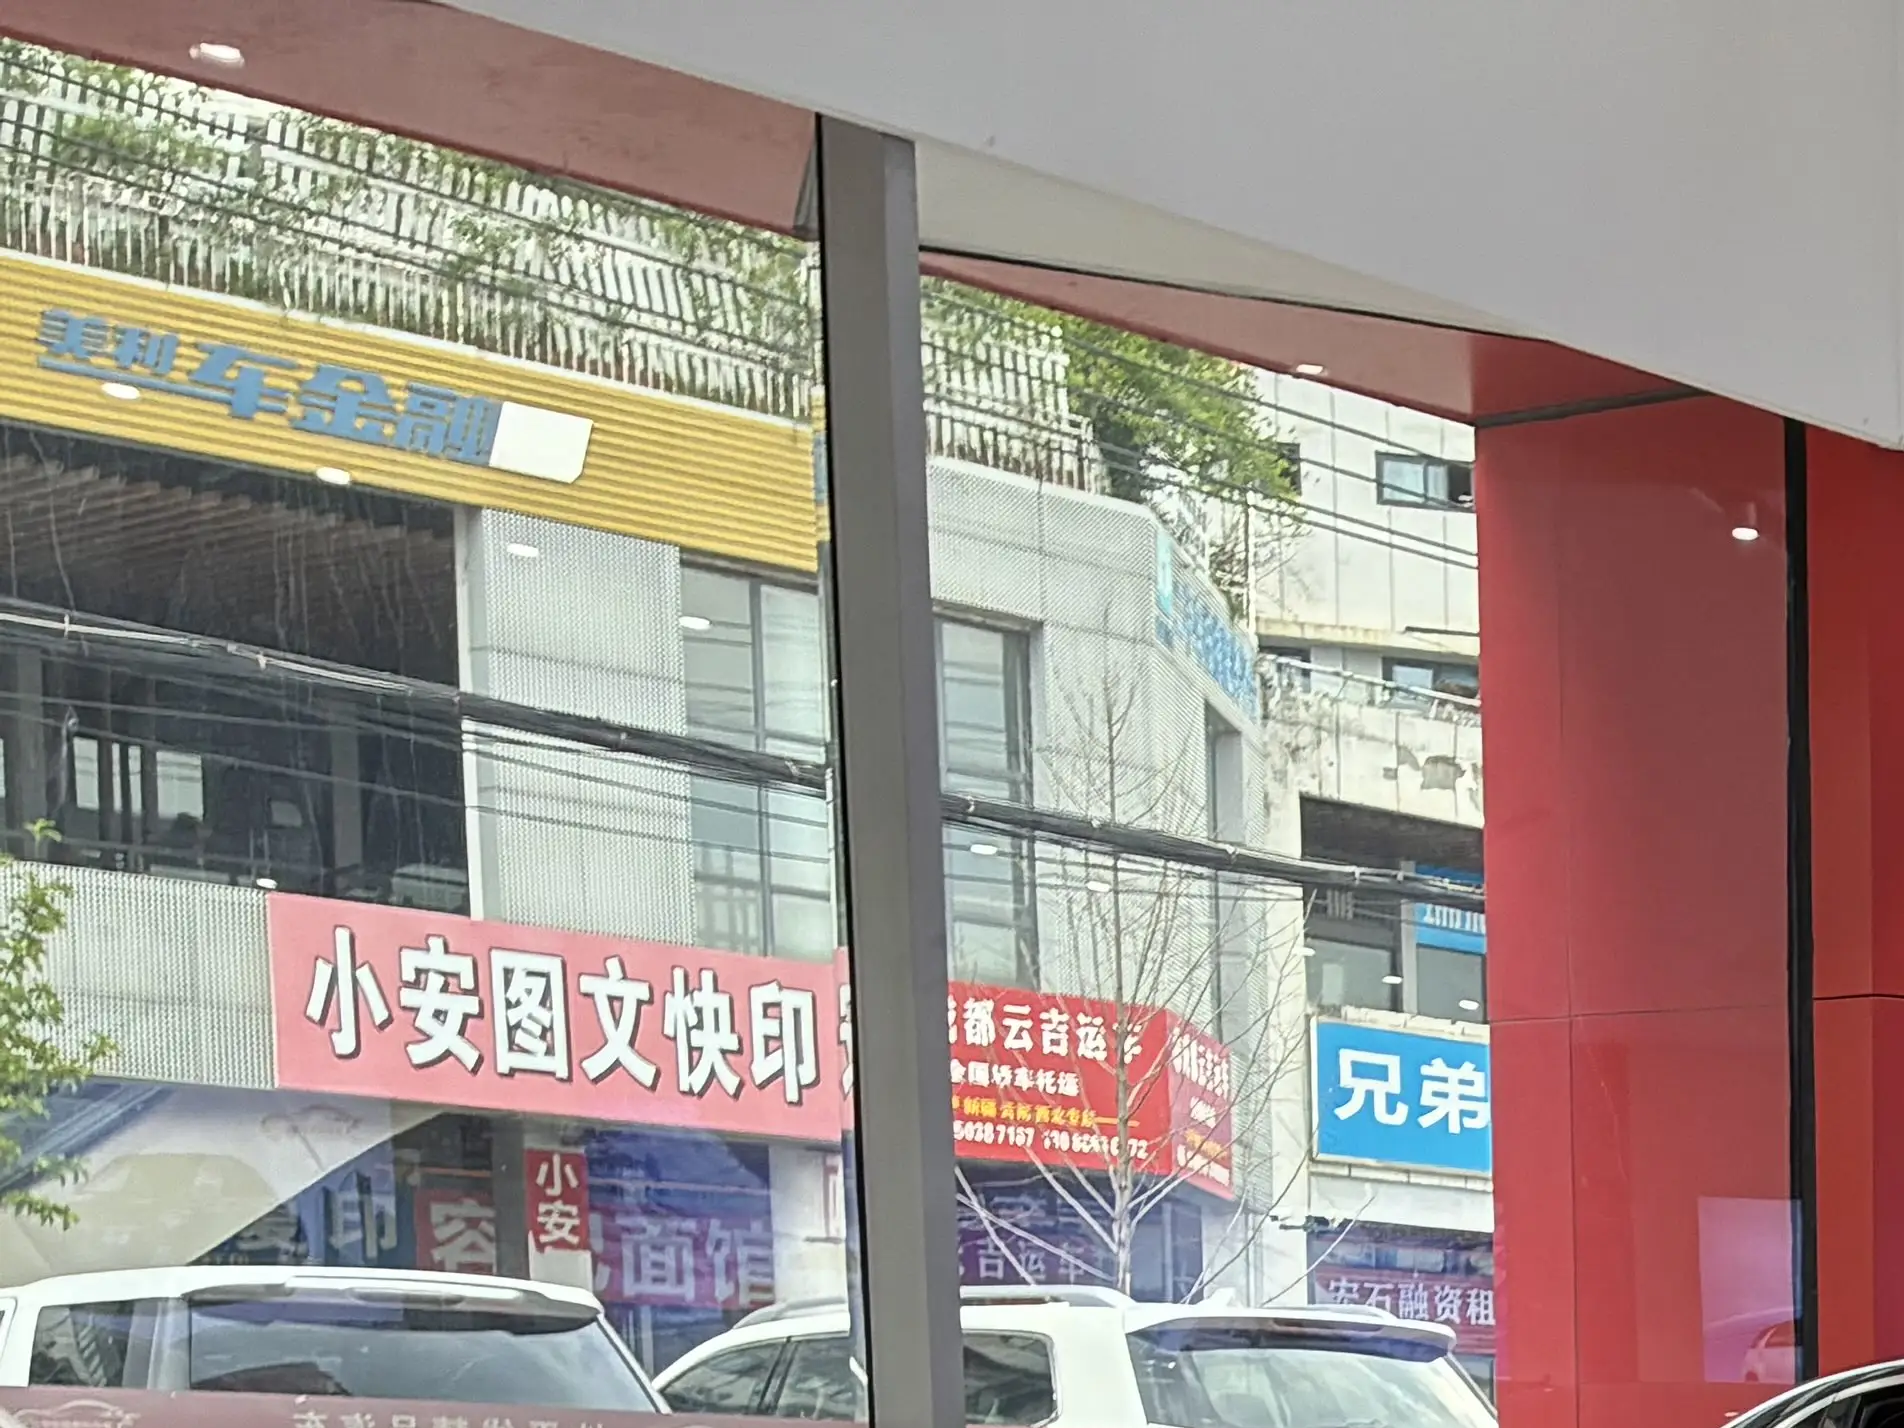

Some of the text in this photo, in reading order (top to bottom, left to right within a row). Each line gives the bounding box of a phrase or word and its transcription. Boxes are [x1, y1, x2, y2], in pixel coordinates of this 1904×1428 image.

[305, 926, 818, 1105] 小安图文快印
[1336, 1047, 1488, 1135] 兄弟
[536, 1152, 580, 1252] 小安
[589, 1212, 776, 1307] 面馆
[957, 1235, 1085, 1283] 吉运车
